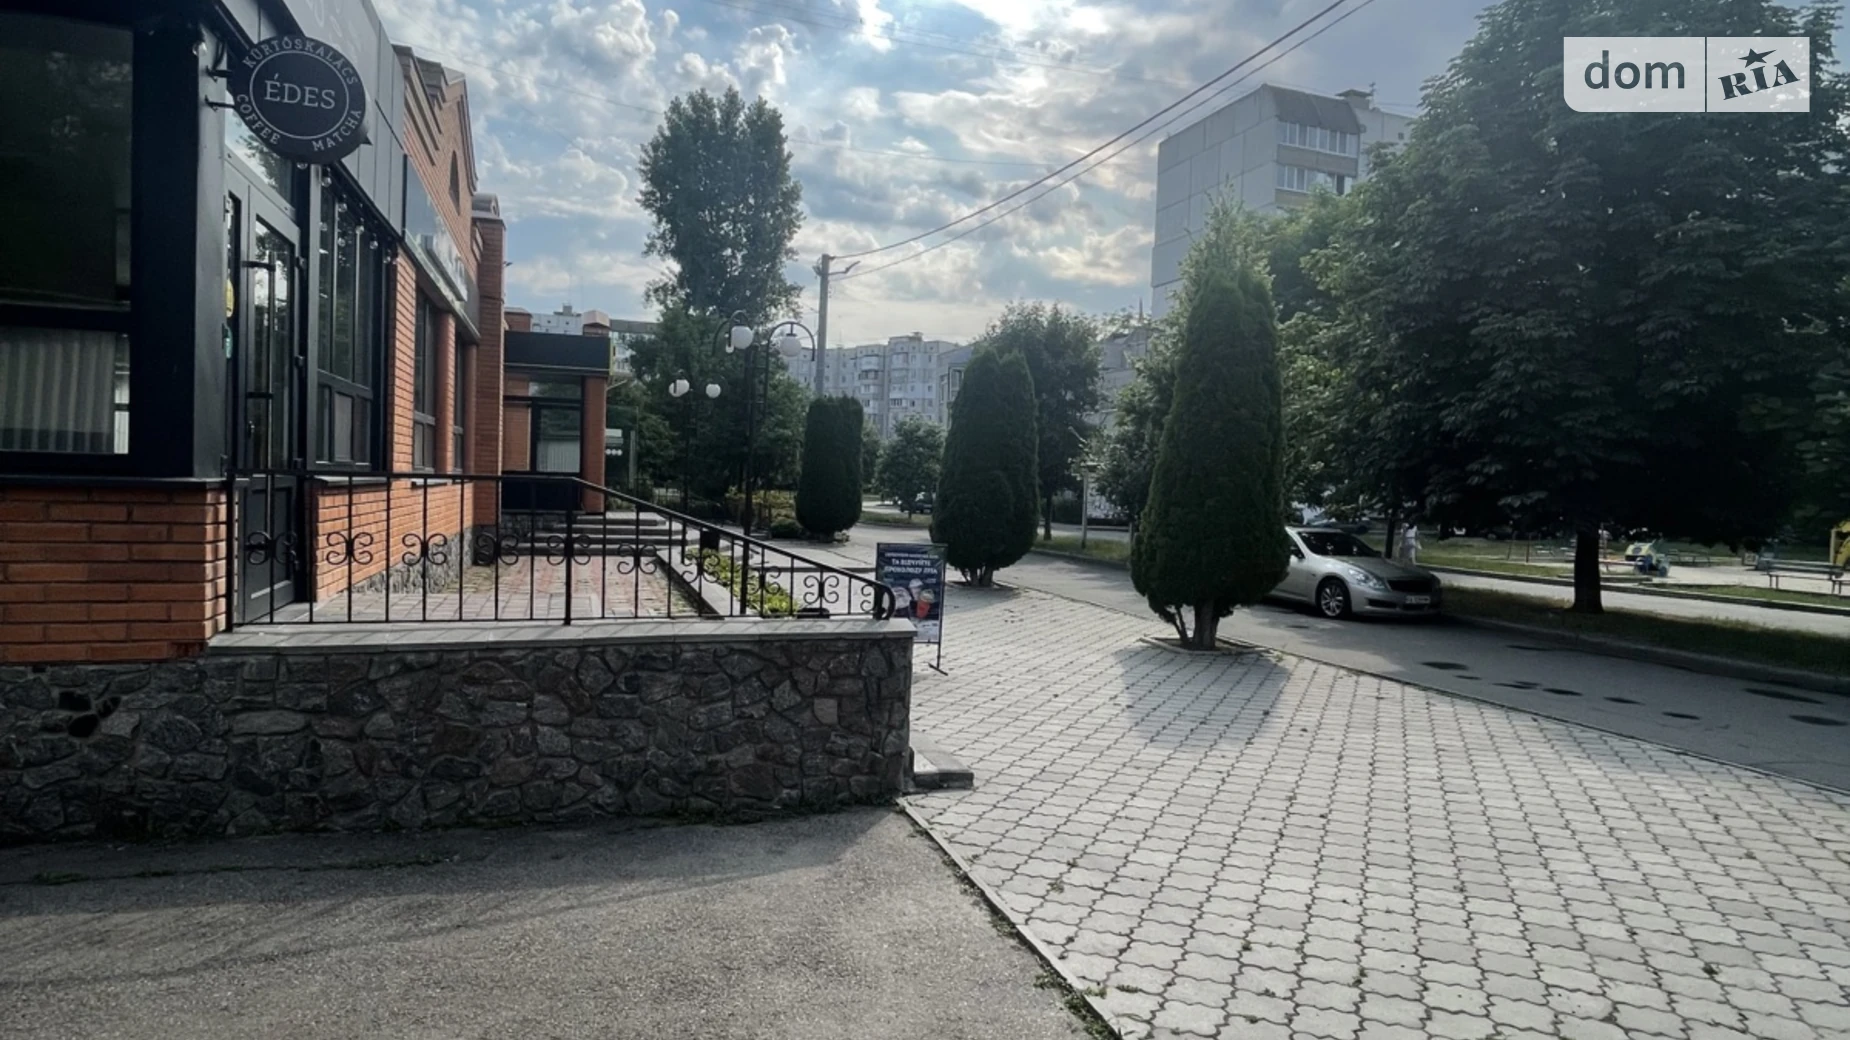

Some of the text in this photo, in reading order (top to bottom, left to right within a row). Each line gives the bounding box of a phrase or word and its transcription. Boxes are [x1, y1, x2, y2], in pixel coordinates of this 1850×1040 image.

[264, 73, 335, 109] ÉDES
[237, 94, 280, 144] COFFEE
[312, 110, 361, 151] MATCHA
